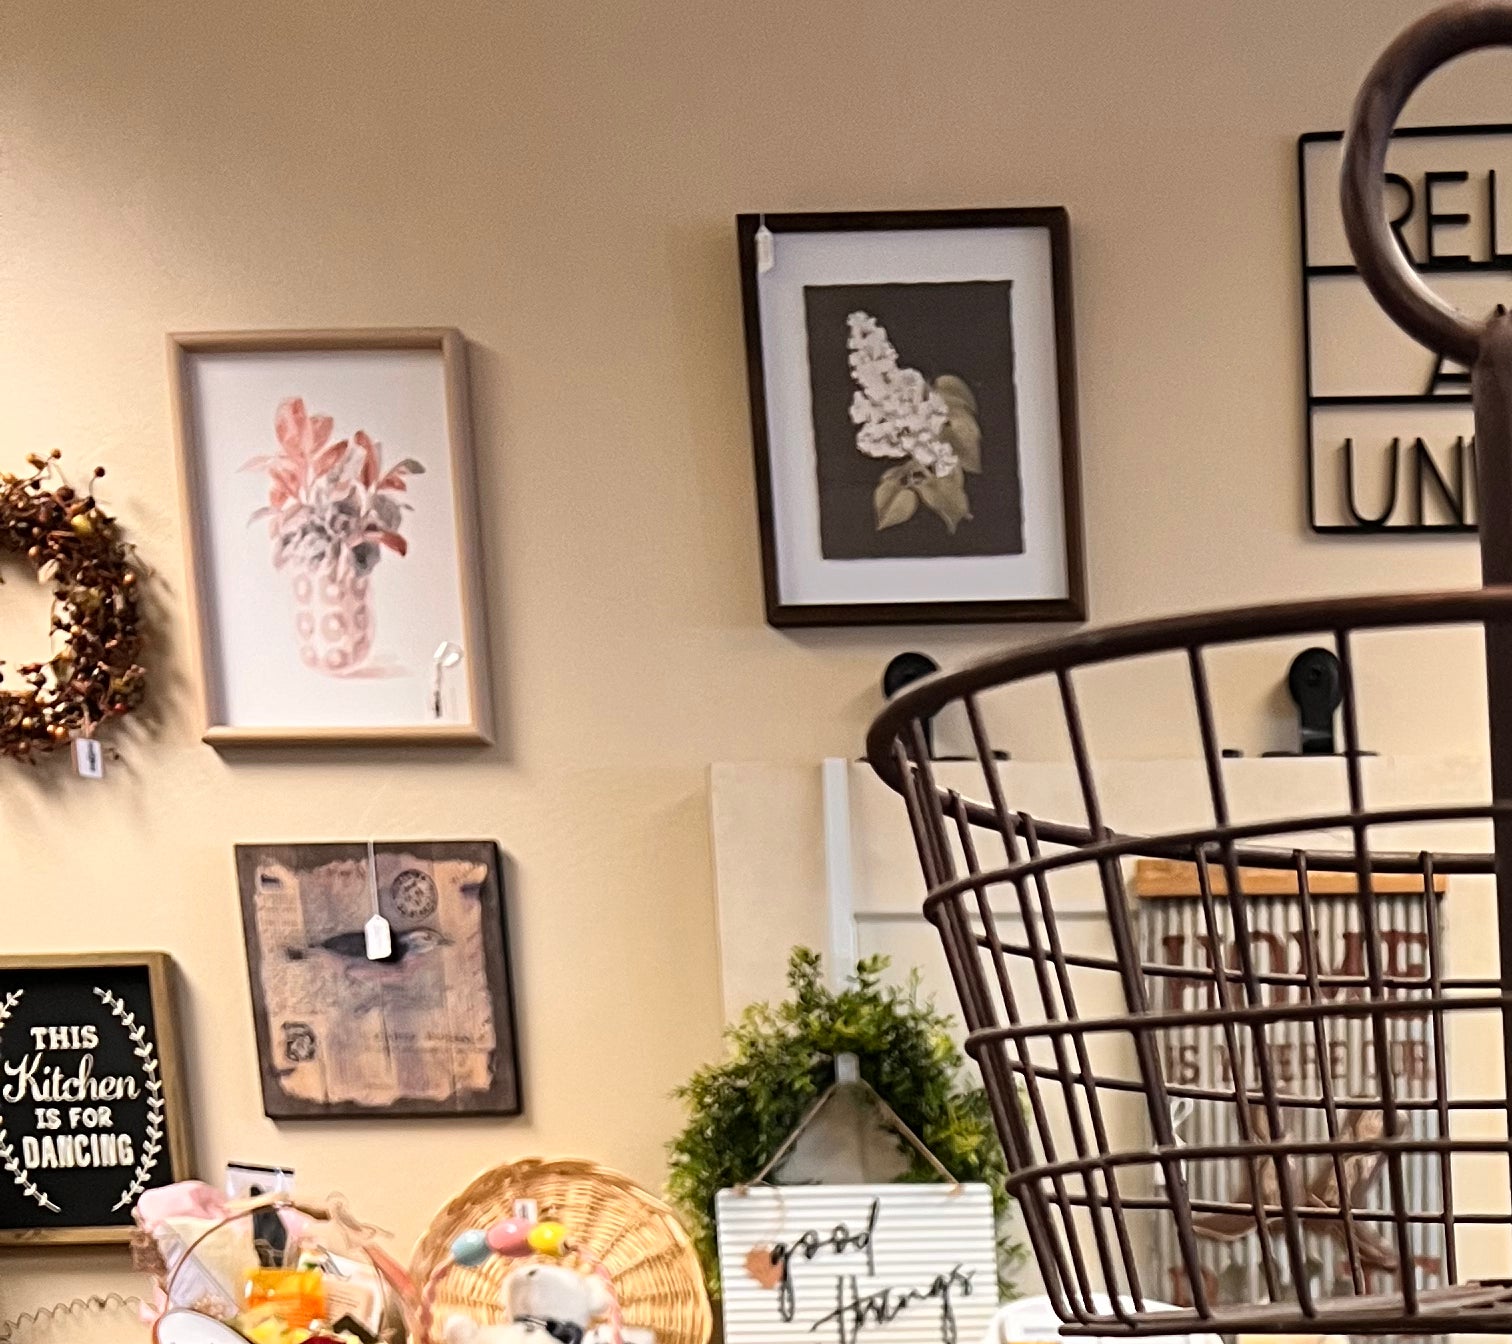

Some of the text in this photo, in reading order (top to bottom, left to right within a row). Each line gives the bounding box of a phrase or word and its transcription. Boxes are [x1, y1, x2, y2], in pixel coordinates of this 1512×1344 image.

[30, 1025, 99, 1050] THIS
[2, 1052, 140, 1103] Kitchen
[35, 1106, 113, 1130] IS FOR
[22, 1134, 135, 1169] DANCING
[768, 1197, 879, 1323] good
